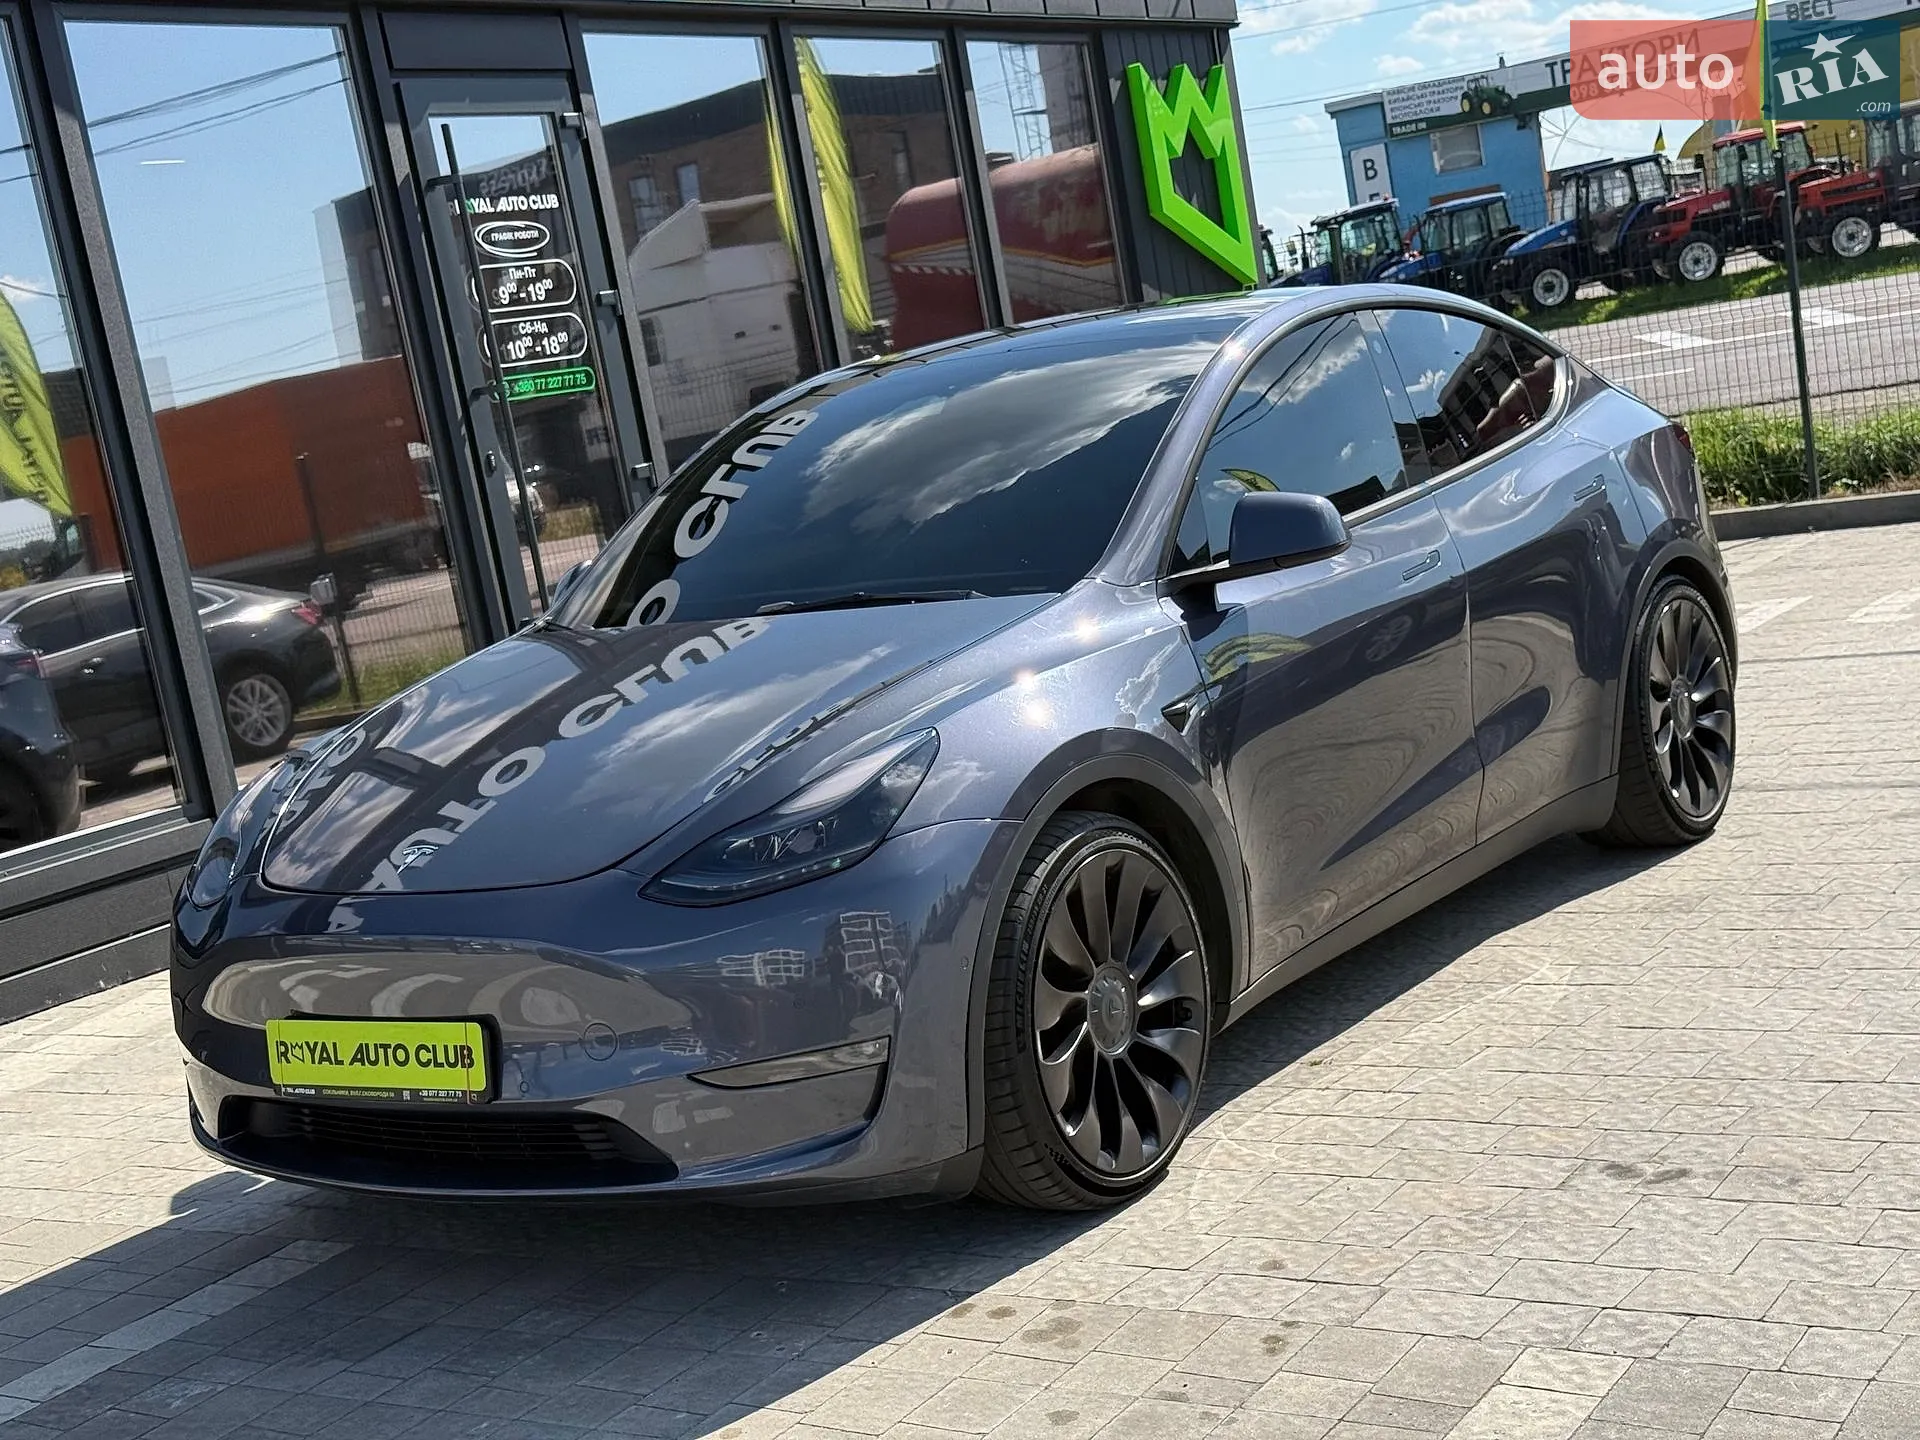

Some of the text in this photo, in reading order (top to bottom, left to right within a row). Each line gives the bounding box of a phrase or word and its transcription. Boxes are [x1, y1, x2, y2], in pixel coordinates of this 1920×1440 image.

[496, 195, 528, 212] AUTO
[529, 193, 559, 210] CLUB
[575, 373, 587, 385] 75
[349, 1042, 410, 1067] AUTO
[415, 1043, 475, 1069] CLUB
